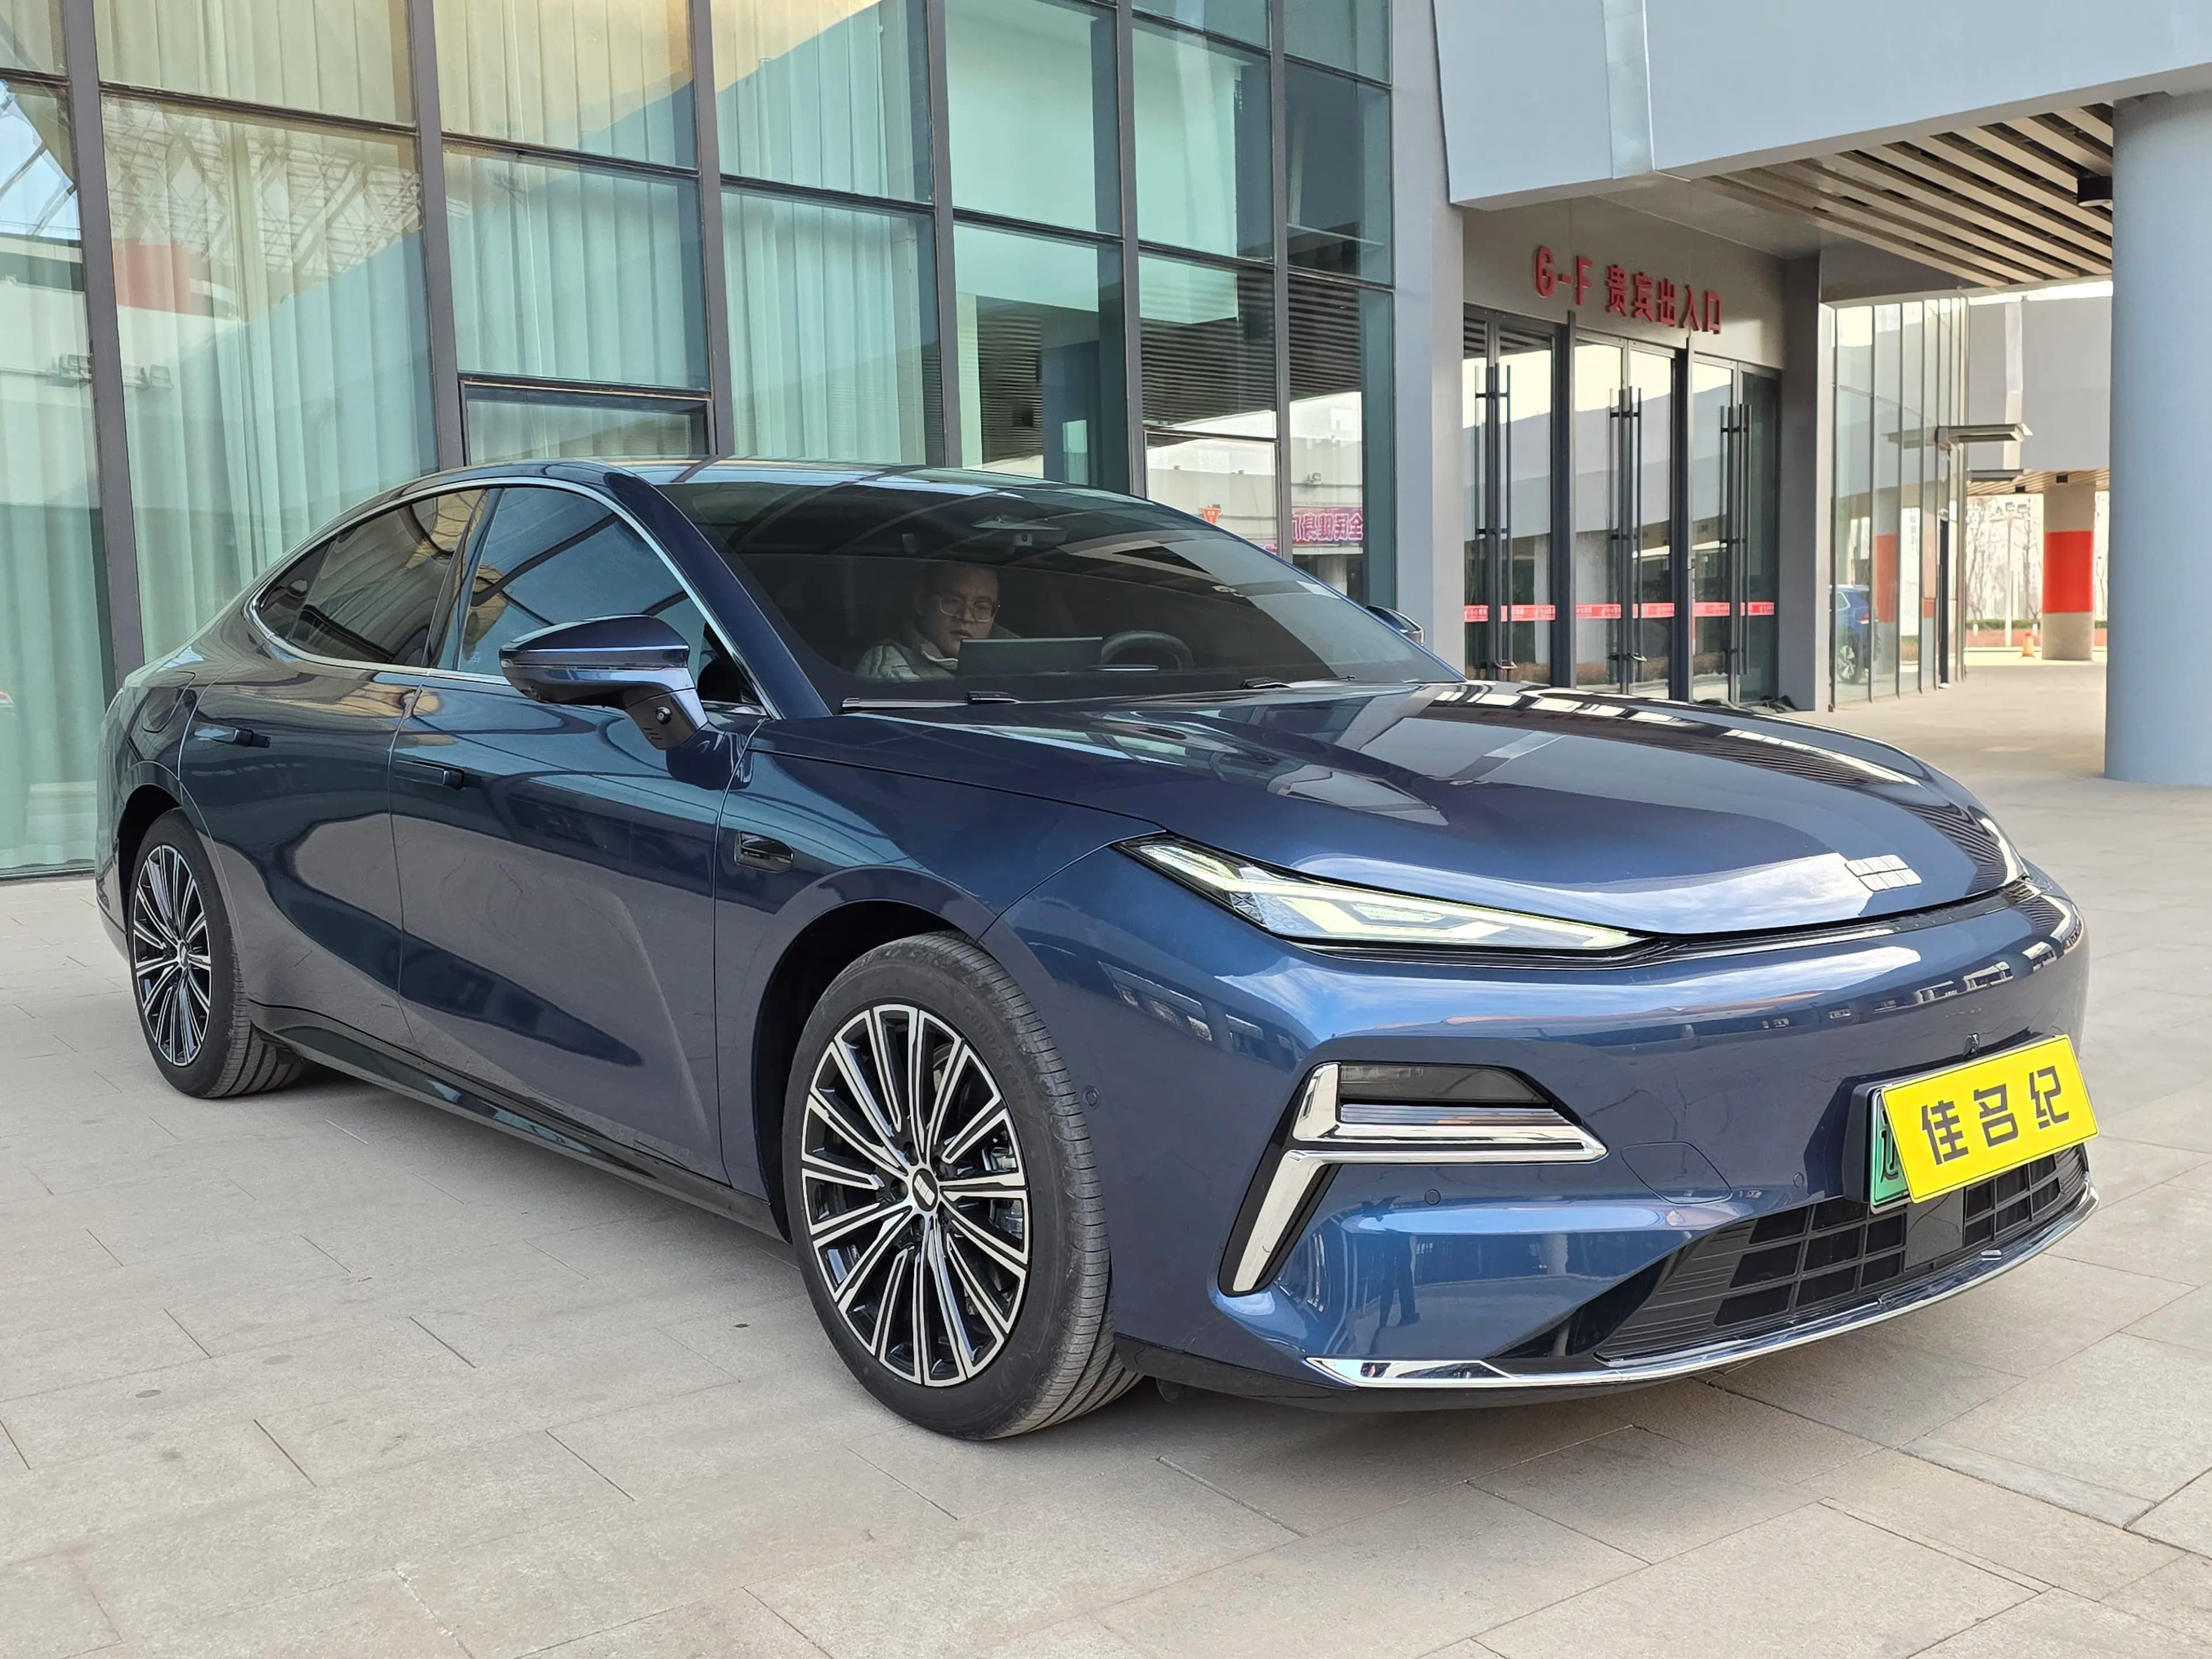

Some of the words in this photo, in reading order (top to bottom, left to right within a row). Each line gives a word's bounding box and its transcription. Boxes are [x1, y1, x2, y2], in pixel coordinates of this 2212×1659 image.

[1535, 245, 1592, 305] G-F
[1605, 264, 1723, 334] 贵宾出入口
[1921, 1065, 2070, 1166] 佳名纪
